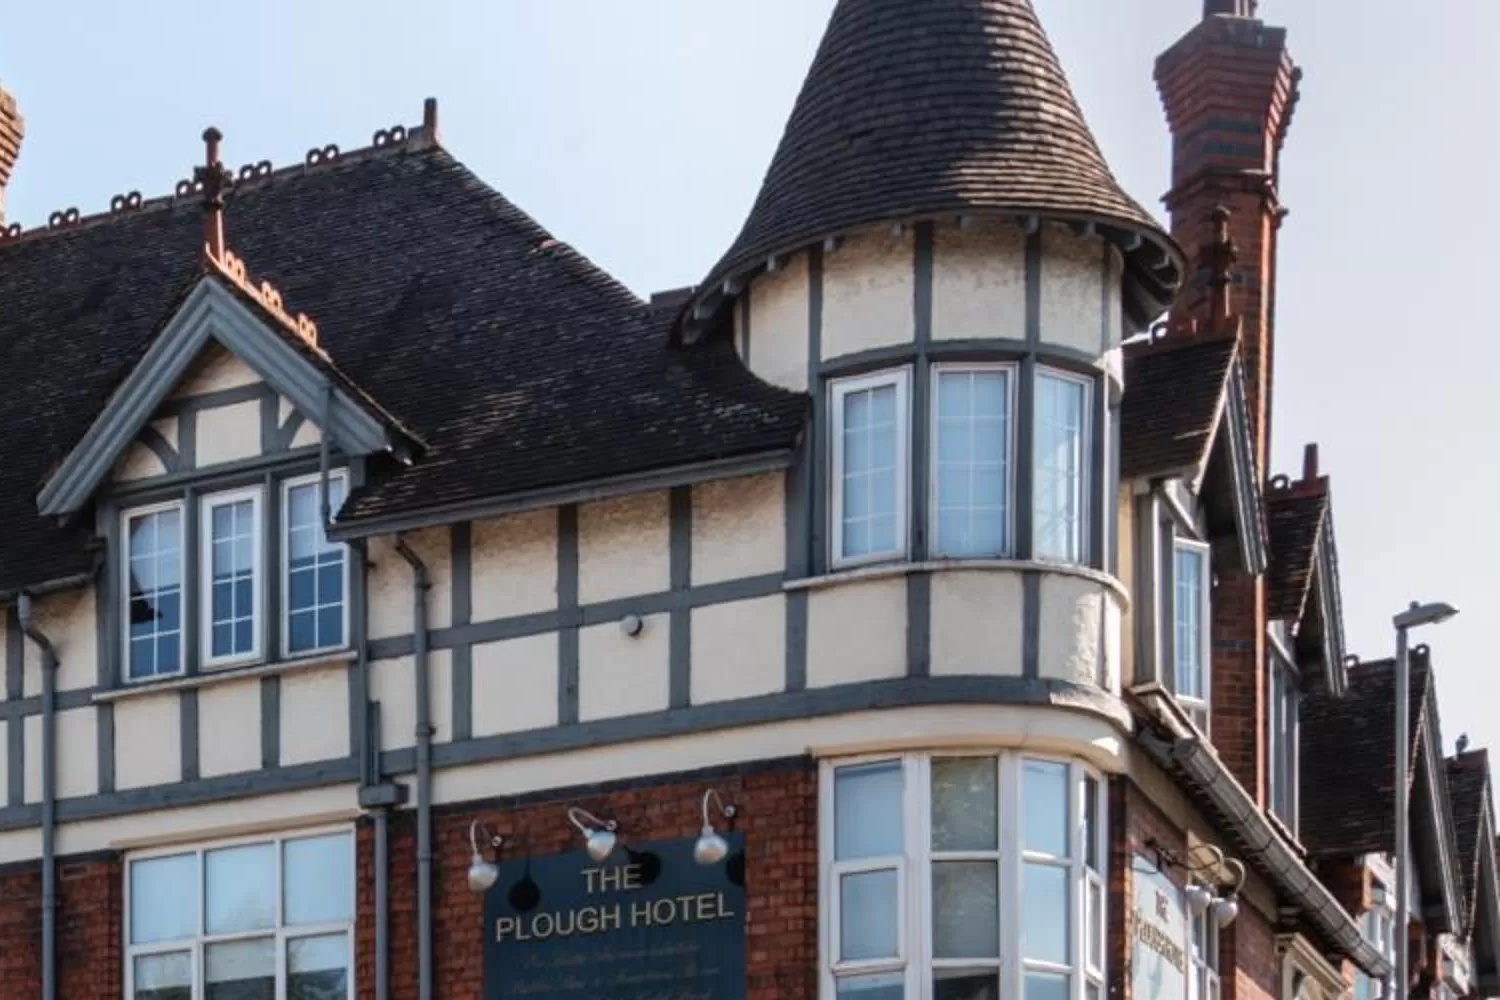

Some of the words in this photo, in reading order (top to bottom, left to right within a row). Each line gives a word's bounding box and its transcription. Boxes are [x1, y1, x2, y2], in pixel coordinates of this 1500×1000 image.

[581, 863, 642, 894] THE
[495, 903, 621, 942] PLOUGH
[631, 892, 734, 927] HOTEL
